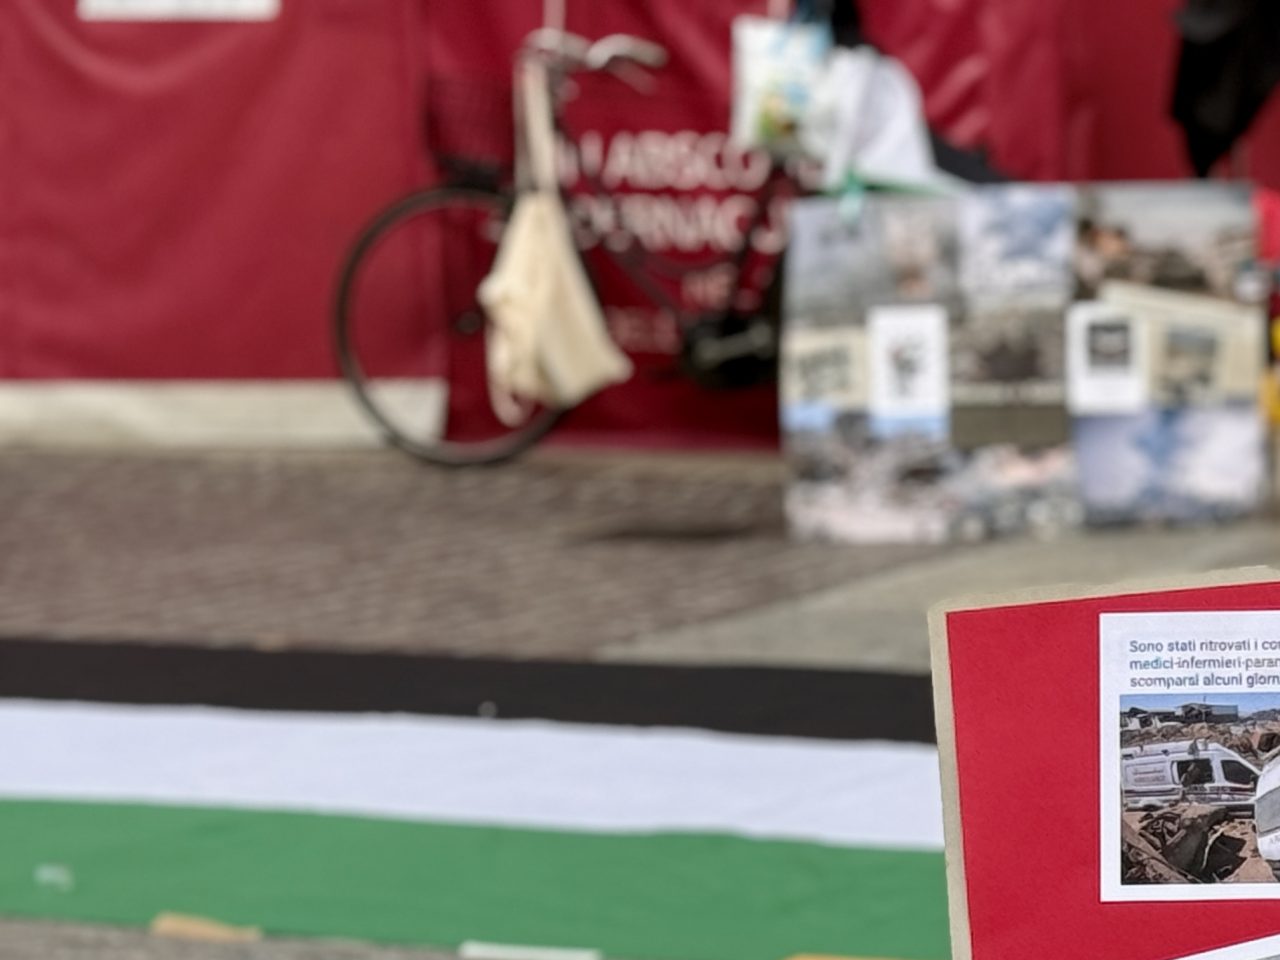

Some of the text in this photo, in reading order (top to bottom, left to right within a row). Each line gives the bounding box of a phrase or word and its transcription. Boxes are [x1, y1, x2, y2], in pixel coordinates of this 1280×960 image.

[1129, 640, 1164, 652] Sono
[1167, 640, 1196, 652] stati
[1200, 638, 1251, 652] ritrovati
[1130, 673, 1199, 690] scomparsi
[1203, 672, 1243, 687] alcuni
